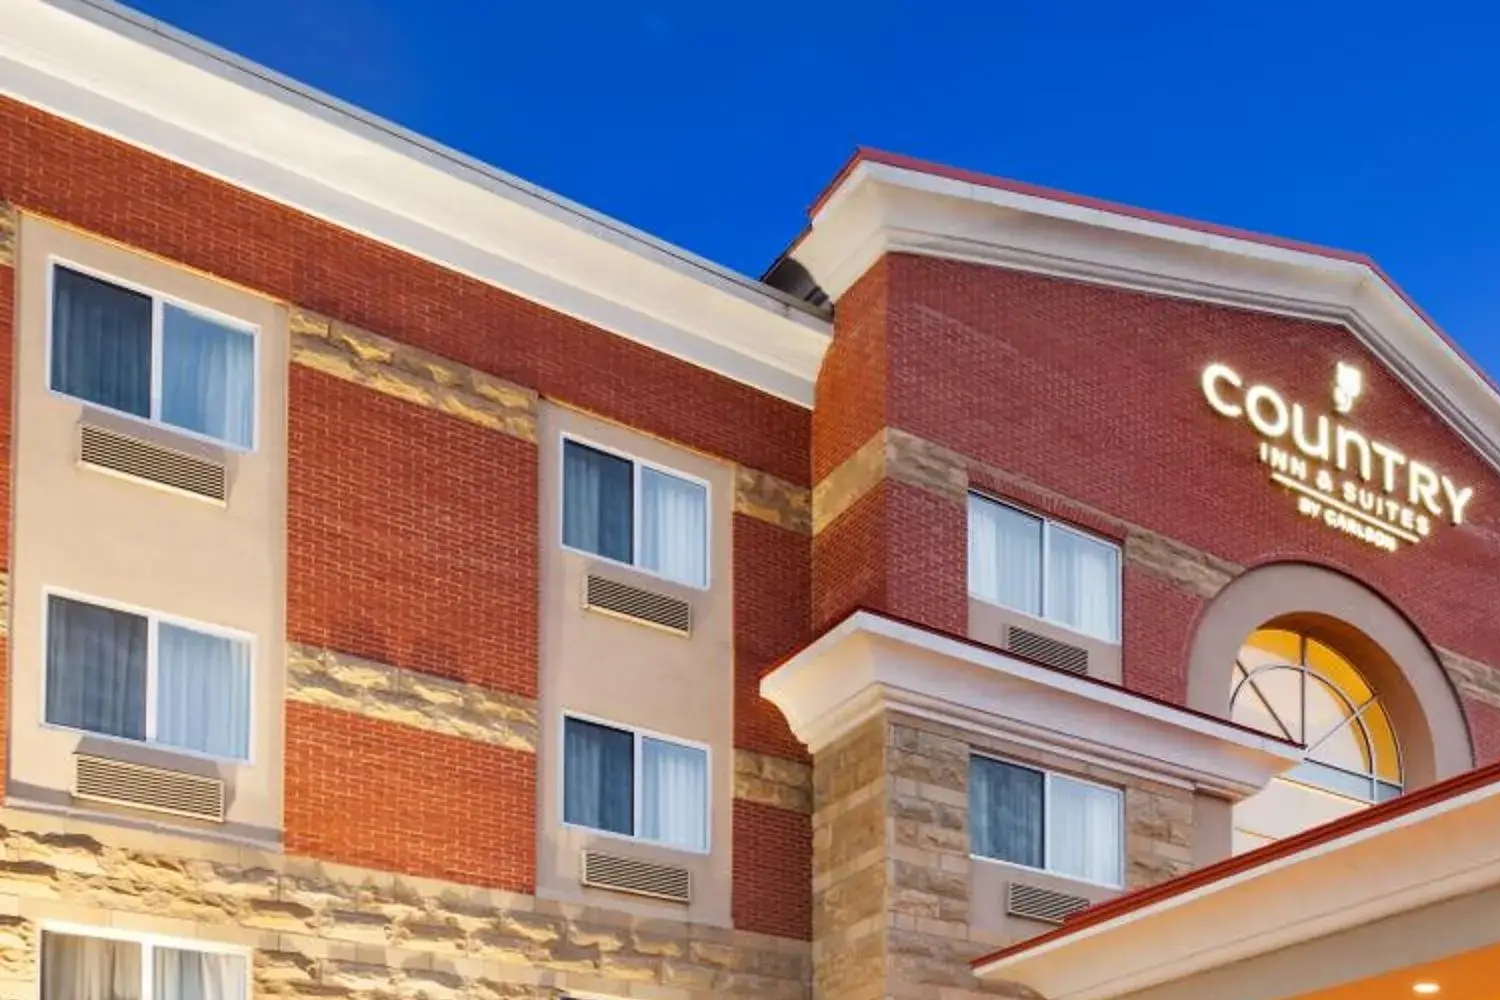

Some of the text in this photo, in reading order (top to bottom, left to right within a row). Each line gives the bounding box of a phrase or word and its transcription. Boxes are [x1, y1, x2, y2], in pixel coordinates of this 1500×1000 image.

[1259, 442, 1430, 536] INN & SUITES
[1298, 496, 1321, 518] BY
